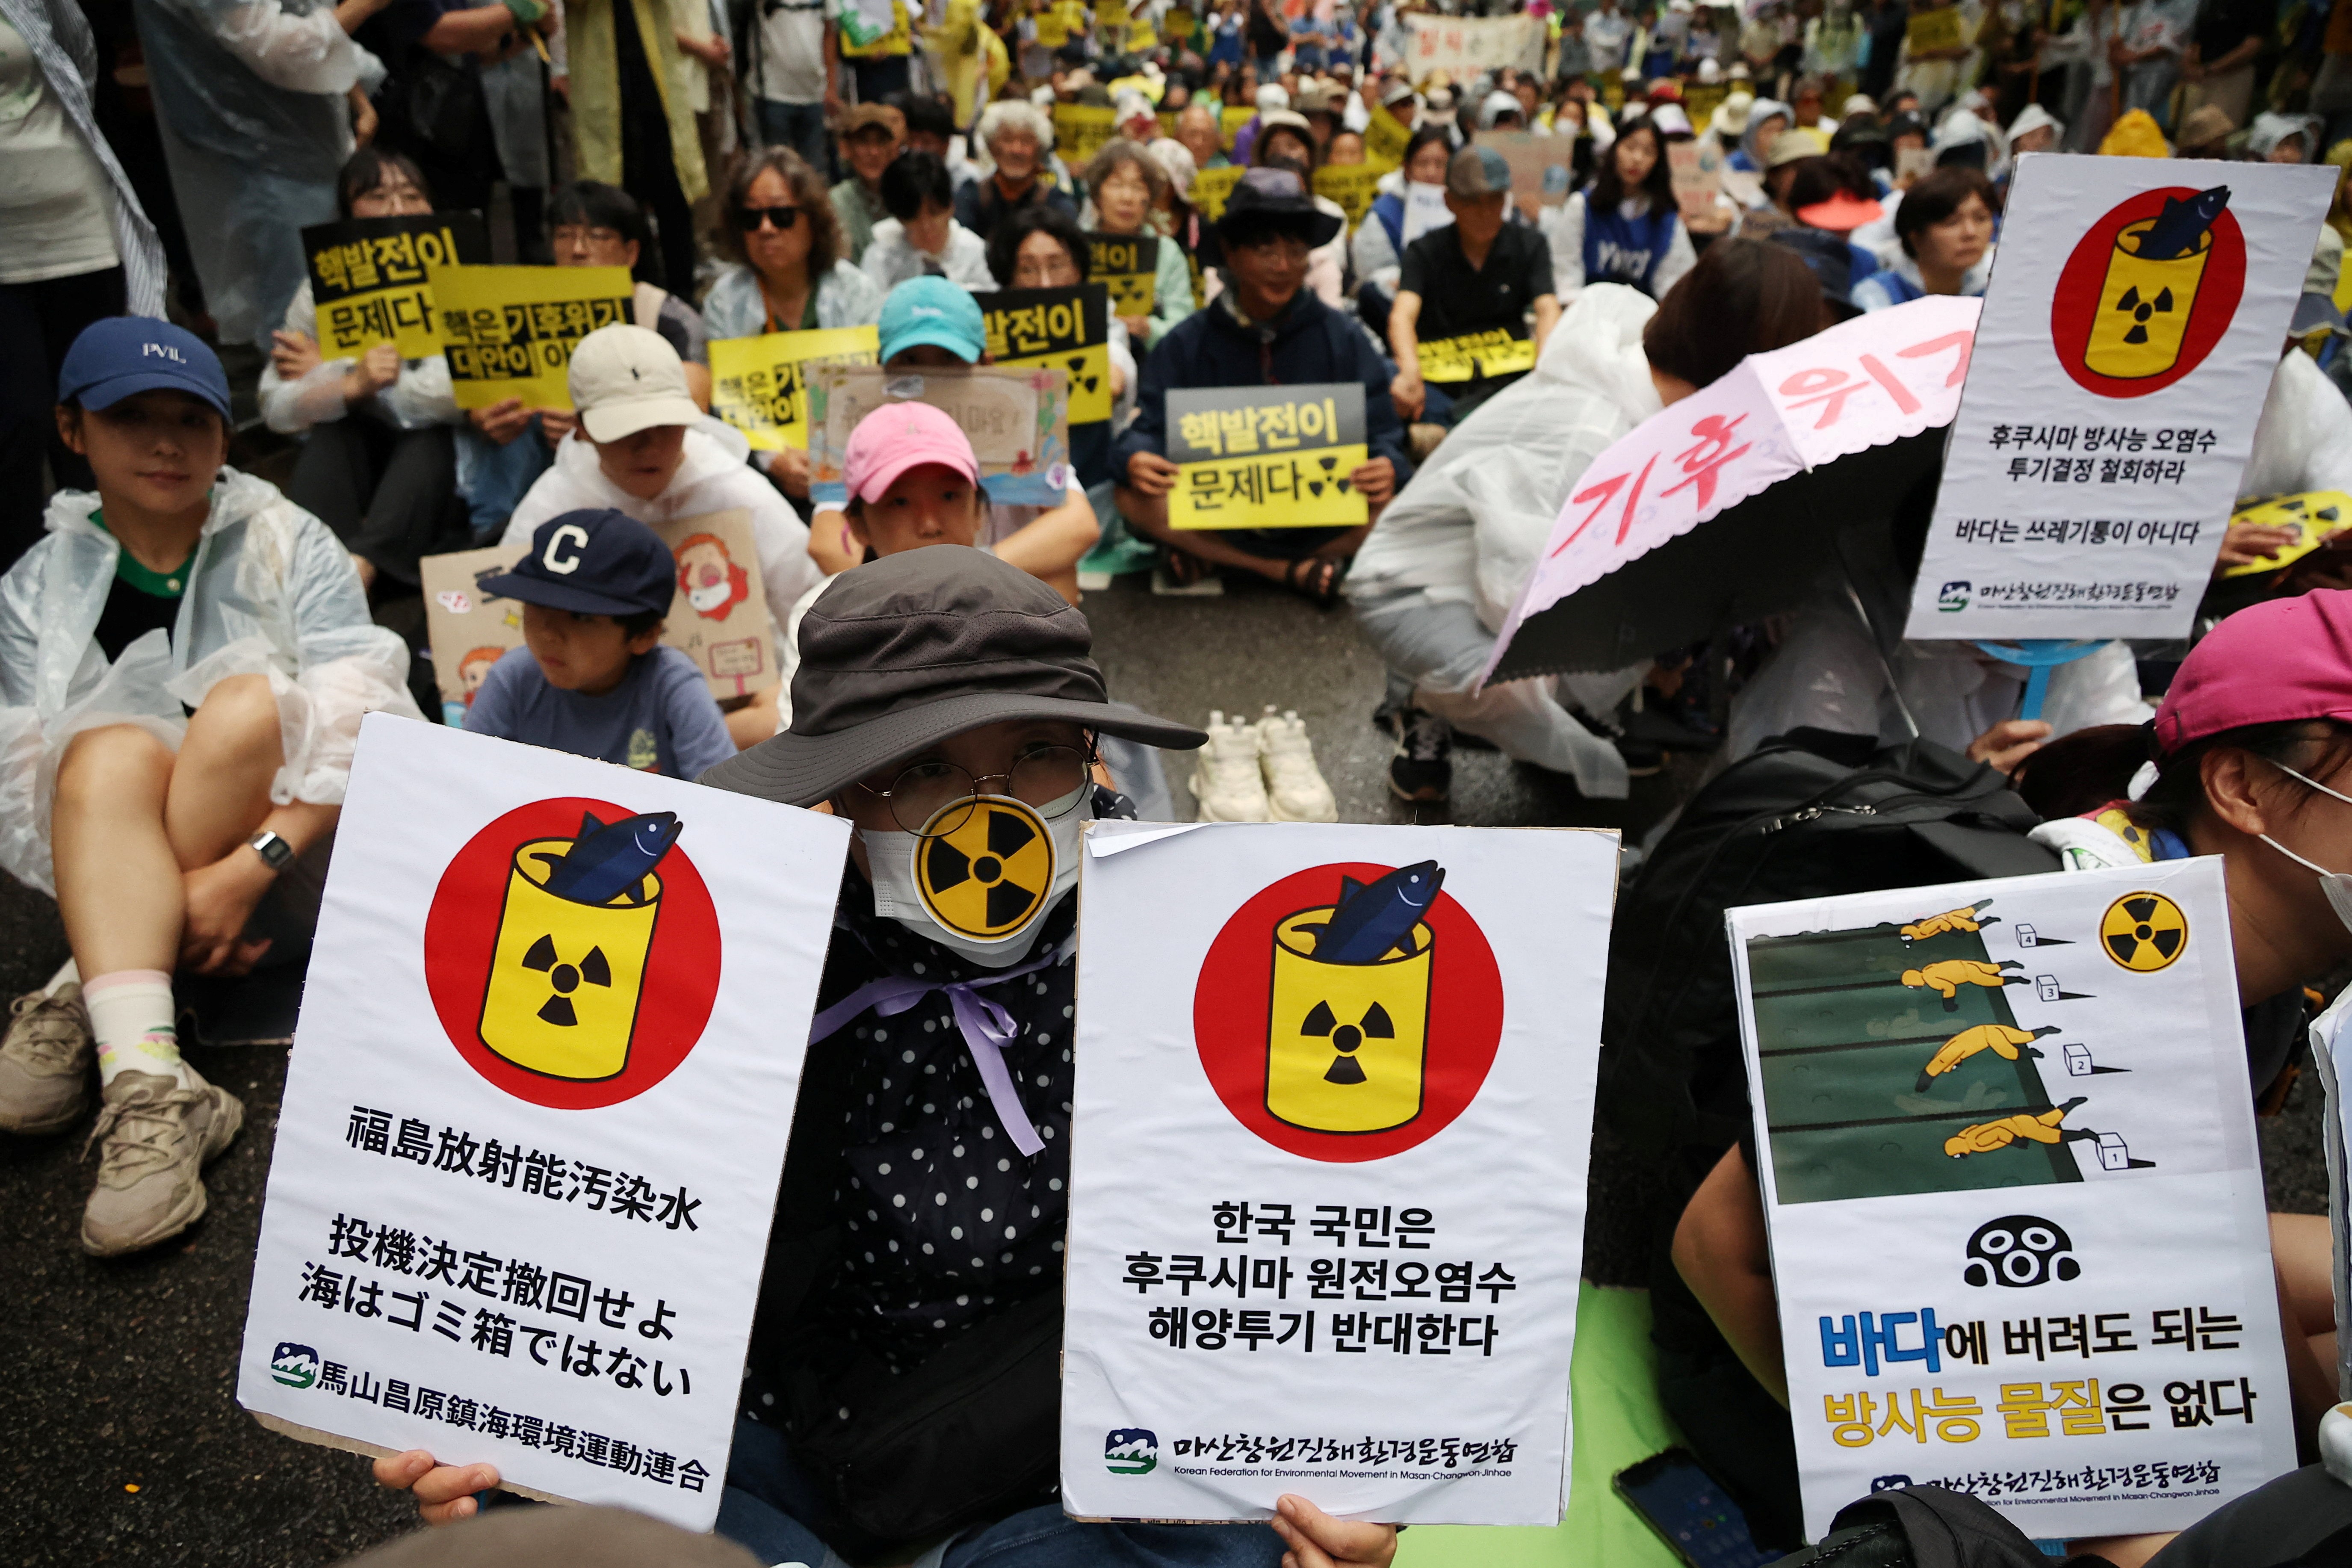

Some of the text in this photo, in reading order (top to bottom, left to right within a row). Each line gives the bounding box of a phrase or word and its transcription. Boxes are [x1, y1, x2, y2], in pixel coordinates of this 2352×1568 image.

[313, 226, 459, 292] 핵발전이
[331, 293, 435, 349] 문제다
[504, 298, 628, 341] 기후위기
[983, 298, 1086, 357] 발전이
[1179, 398, 1339, 455] 핵발전이
[1989, 425, 2216, 453] 후쿠시마 방사능 오염수
[1190, 461, 1305, 511] 문제다
[1551, 412, 1752, 557] 기후
[2007, 458, 2185, 484] 투기결정 철회하라
[543, 524, 589, 575] C
[1956, 520, 2199, 545] 바다는 쓰레기통이 아니다
[2025, 936, 2032, 944] 4
[2048, 988, 2054, 998] 3
[2077, 1061, 2085, 1071] 2
[346, 1106, 702, 1231] 福島放射能汚染水
[2112, 1153, 2119, 1163] 1
[1212, 1201, 1435, 1249] 한국 국민은
[328, 1213, 677, 1342] 投機決定撤回せよ
[1123, 1251, 1516, 1303] 후쿠시마 원전오염수
[297, 1261, 690, 1396] 海はゴミ箱ではない
[1149, 1307, 1498, 1356] 해양투기 반대한다
[1818, 1307, 2242, 1376] 바다에 버려도 되는
[1823, 1377, 2256, 1447] 방사능 물질은 없다
[1173, 1433, 1518, 1468] 마산창원진해환경운동연합
[1175, 1467, 1207, 1475] Korean
[1276, 1469, 1337, 1477] Environmental
[2015, 1497, 2068, 1505] Environmental
[2070, 1494, 2111, 1502] Movement
